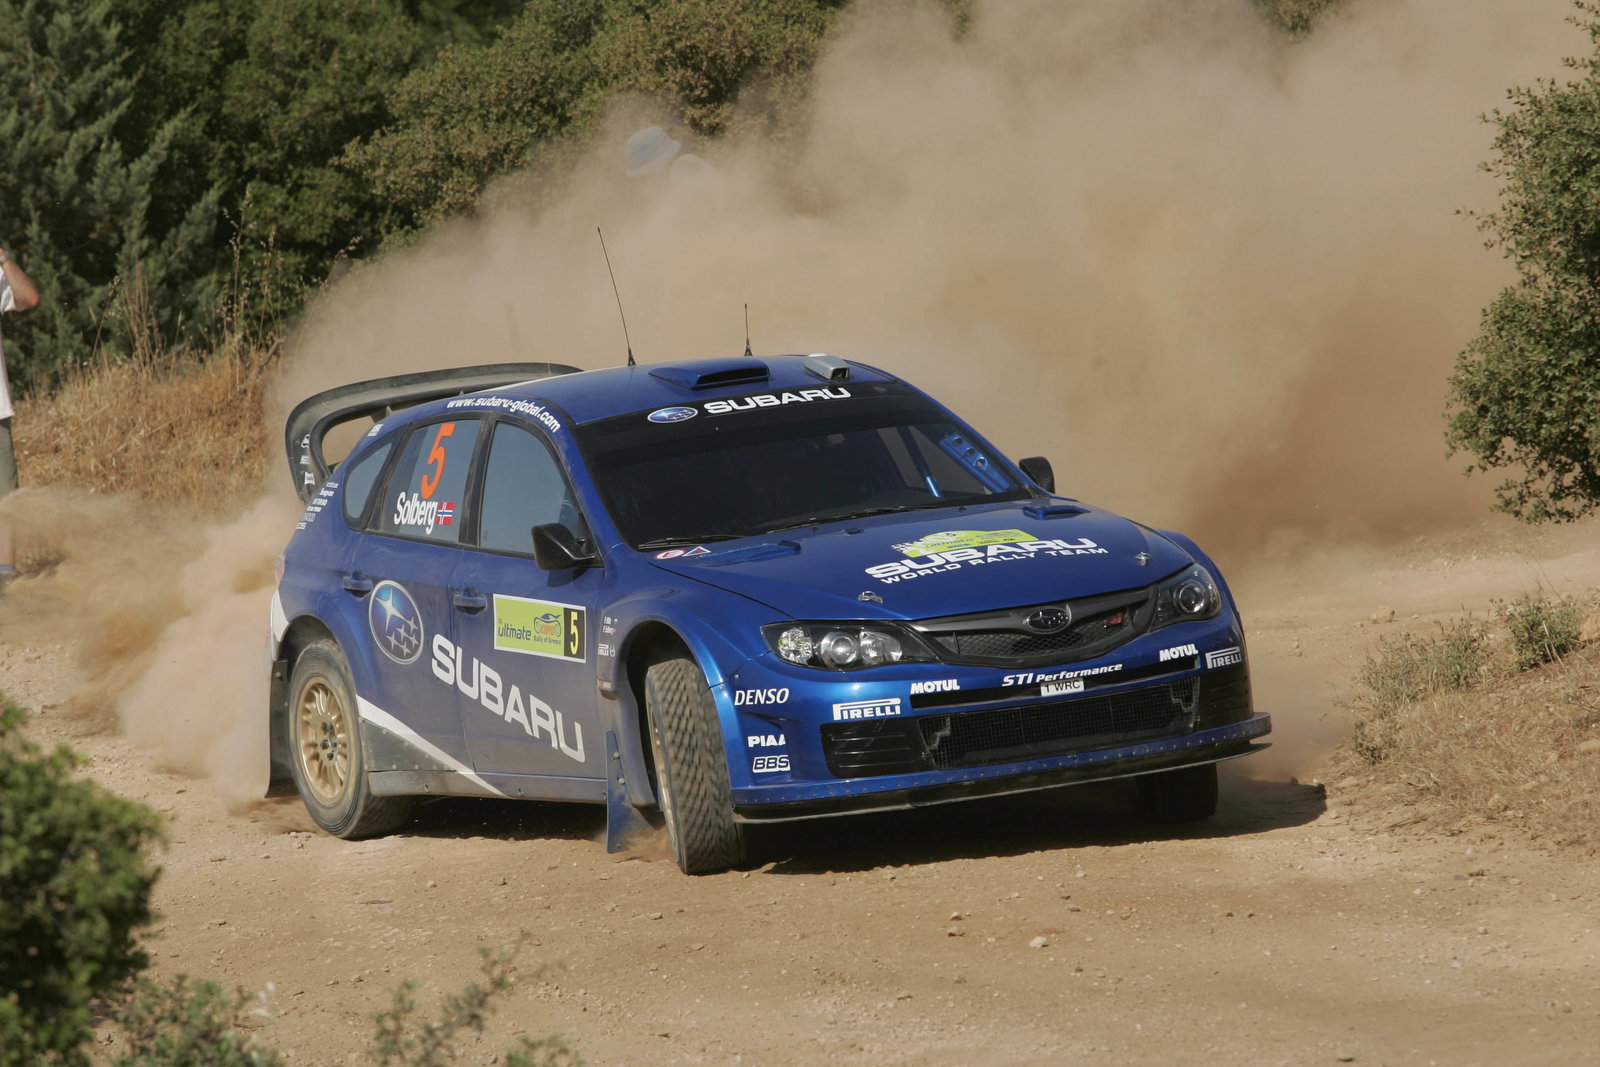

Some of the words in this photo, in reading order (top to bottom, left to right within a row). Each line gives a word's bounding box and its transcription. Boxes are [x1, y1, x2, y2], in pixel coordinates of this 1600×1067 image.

[704, 387, 851, 414] SUBARU
[446, 396, 561, 433] www.subaru-global.com
[420, 423, 456, 499] 5
[394, 492, 439, 535] Solberg
[864, 537, 1099, 580] SUBARU
[880, 562, 962, 585] WORLD
[969, 551, 1037, 566] RALLY
[1044, 547, 1109, 557] TEAM
[498, 622, 532, 641] ultimate
[570, 611, 579, 655] 5
[1160, 643, 1199, 662] MOTUL
[1205, 646, 1242, 669] PIRELLI
[910, 679, 960, 694] MOTUL
[1002, 672, 1034, 687] STI
[1036, 663, 1122, 683] Performance
[1054, 679, 1080, 692] WRC
[431, 633, 586, 763] SUBARU
[734, 688, 790, 706] DENSO
[832, 697, 901, 720] PIRELLI
[753, 755, 790, 772] BBS
